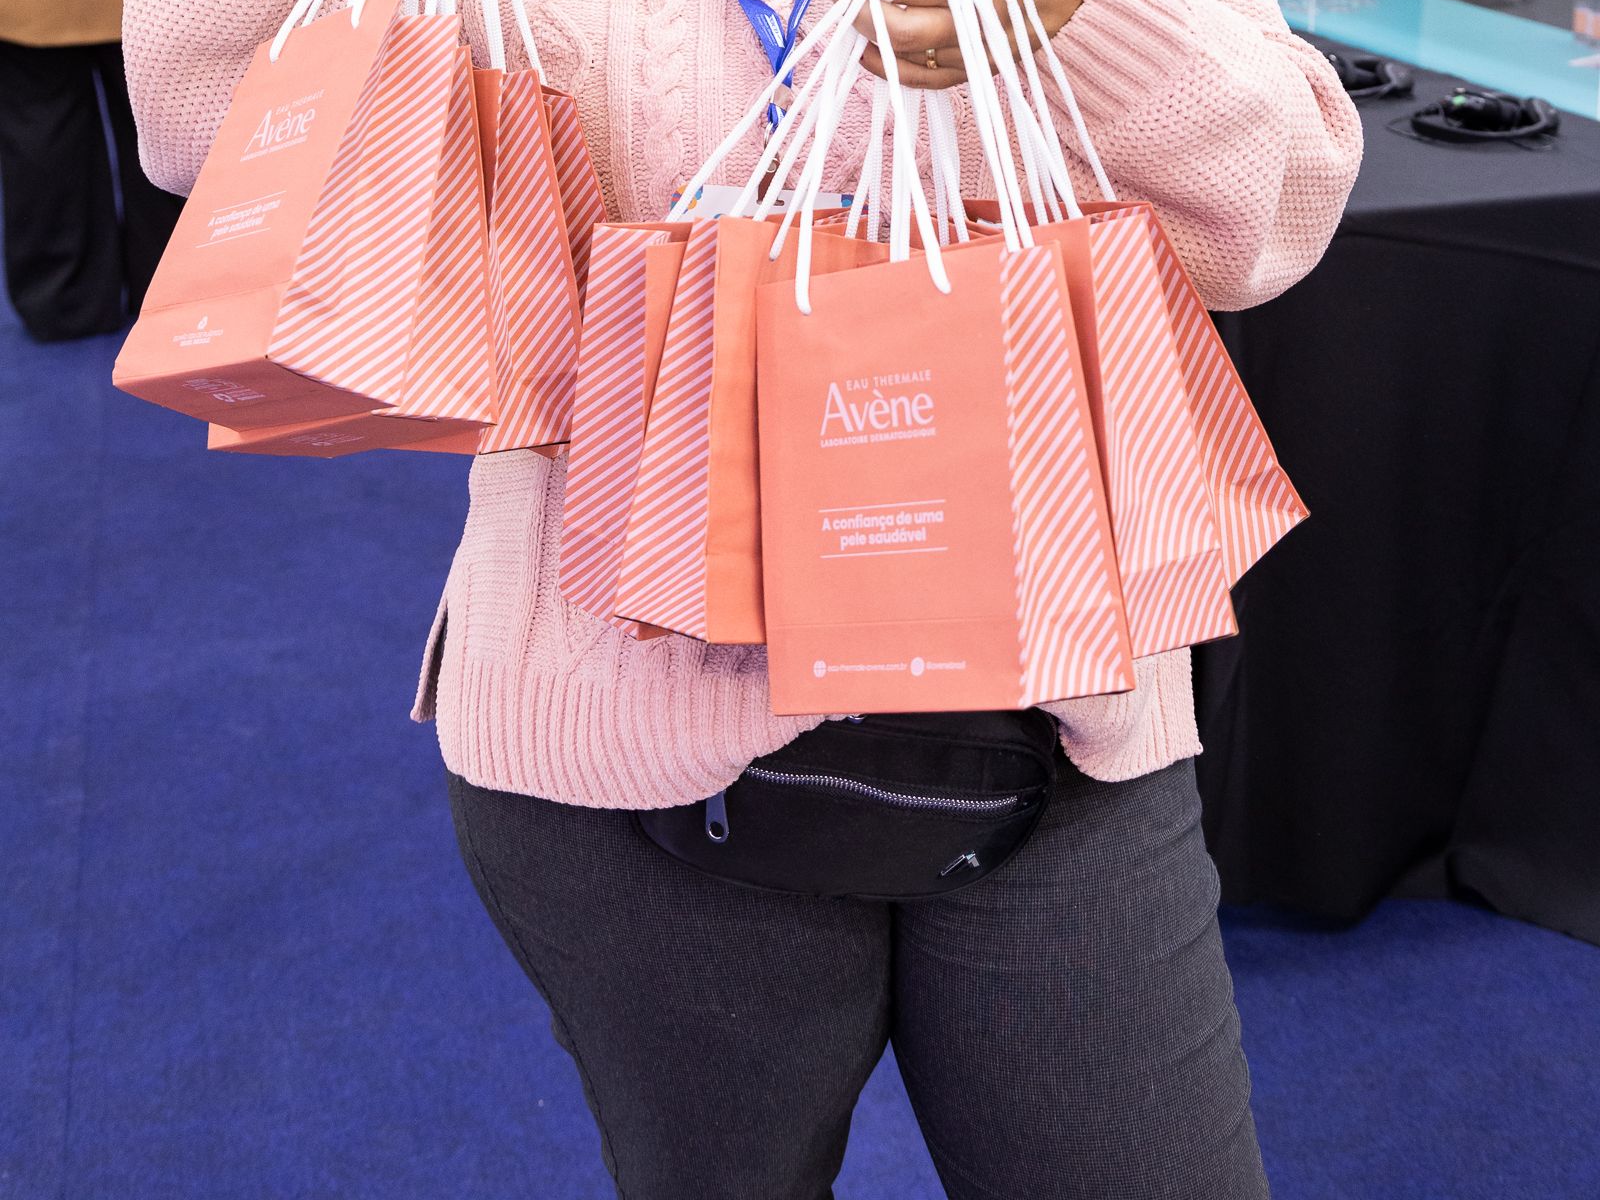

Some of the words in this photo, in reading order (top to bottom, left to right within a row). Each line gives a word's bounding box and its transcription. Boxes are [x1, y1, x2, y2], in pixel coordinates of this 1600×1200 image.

[244, 108, 316, 153] Avène
[846, 379, 869, 392] EAU
[873, 369, 932, 388] THERMALE
[820, 382, 935, 436] Avène
[821, 517, 831, 531] A
[832, 513, 895, 531] confiança
[896, 511, 912, 525] de
[914, 509, 945, 524] uma
[840, 531, 867, 550] pele
[868, 527, 927, 545] saudável
